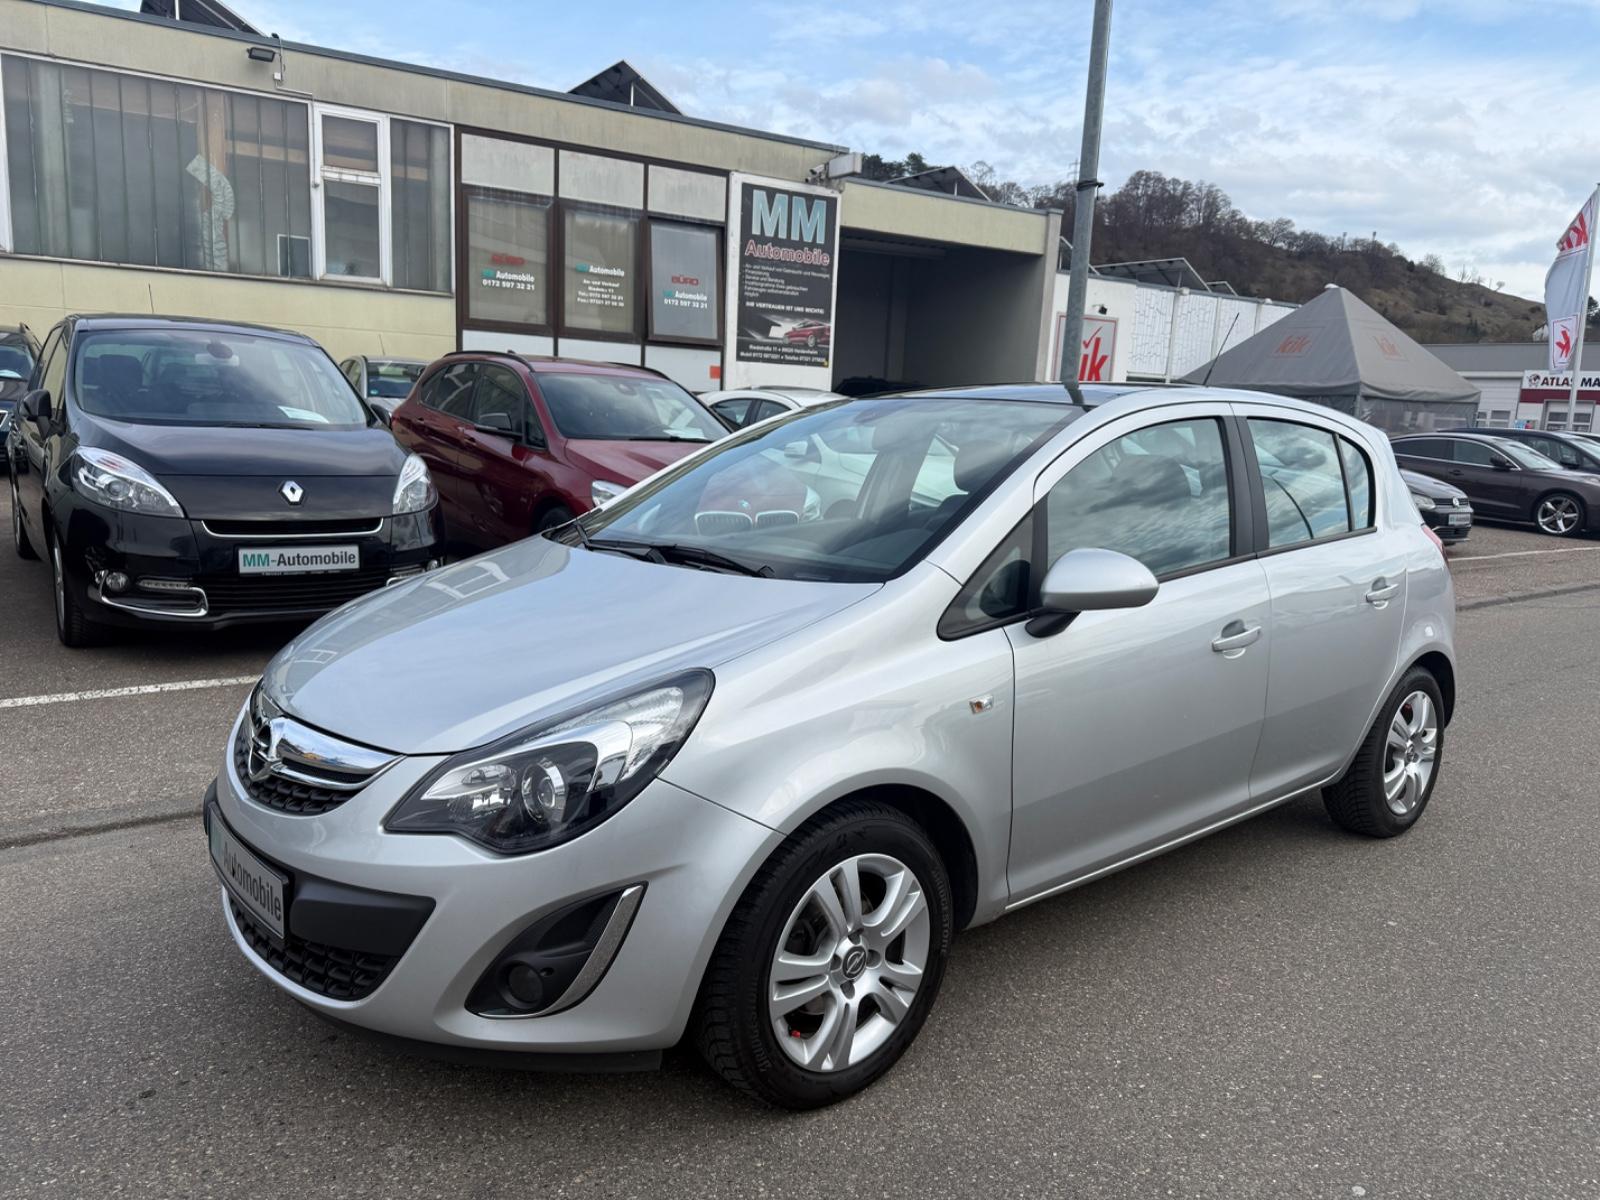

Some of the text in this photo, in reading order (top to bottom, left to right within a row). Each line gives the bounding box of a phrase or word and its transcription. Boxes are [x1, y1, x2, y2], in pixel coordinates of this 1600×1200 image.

[752, 189, 826, 244] MM
[745, 239, 830, 266] Automobile
[496, 270, 535, 282] Automobile
[589, 265, 624, 277] Automobile
[482, 279, 500, 287] 0172
[675, 290, 708, 301] Automobile
[1078, 327, 1108, 382] ik
[1541, 376, 1600, 387] ATLA MA
[242, 551, 356, 568] MM-Automobile
